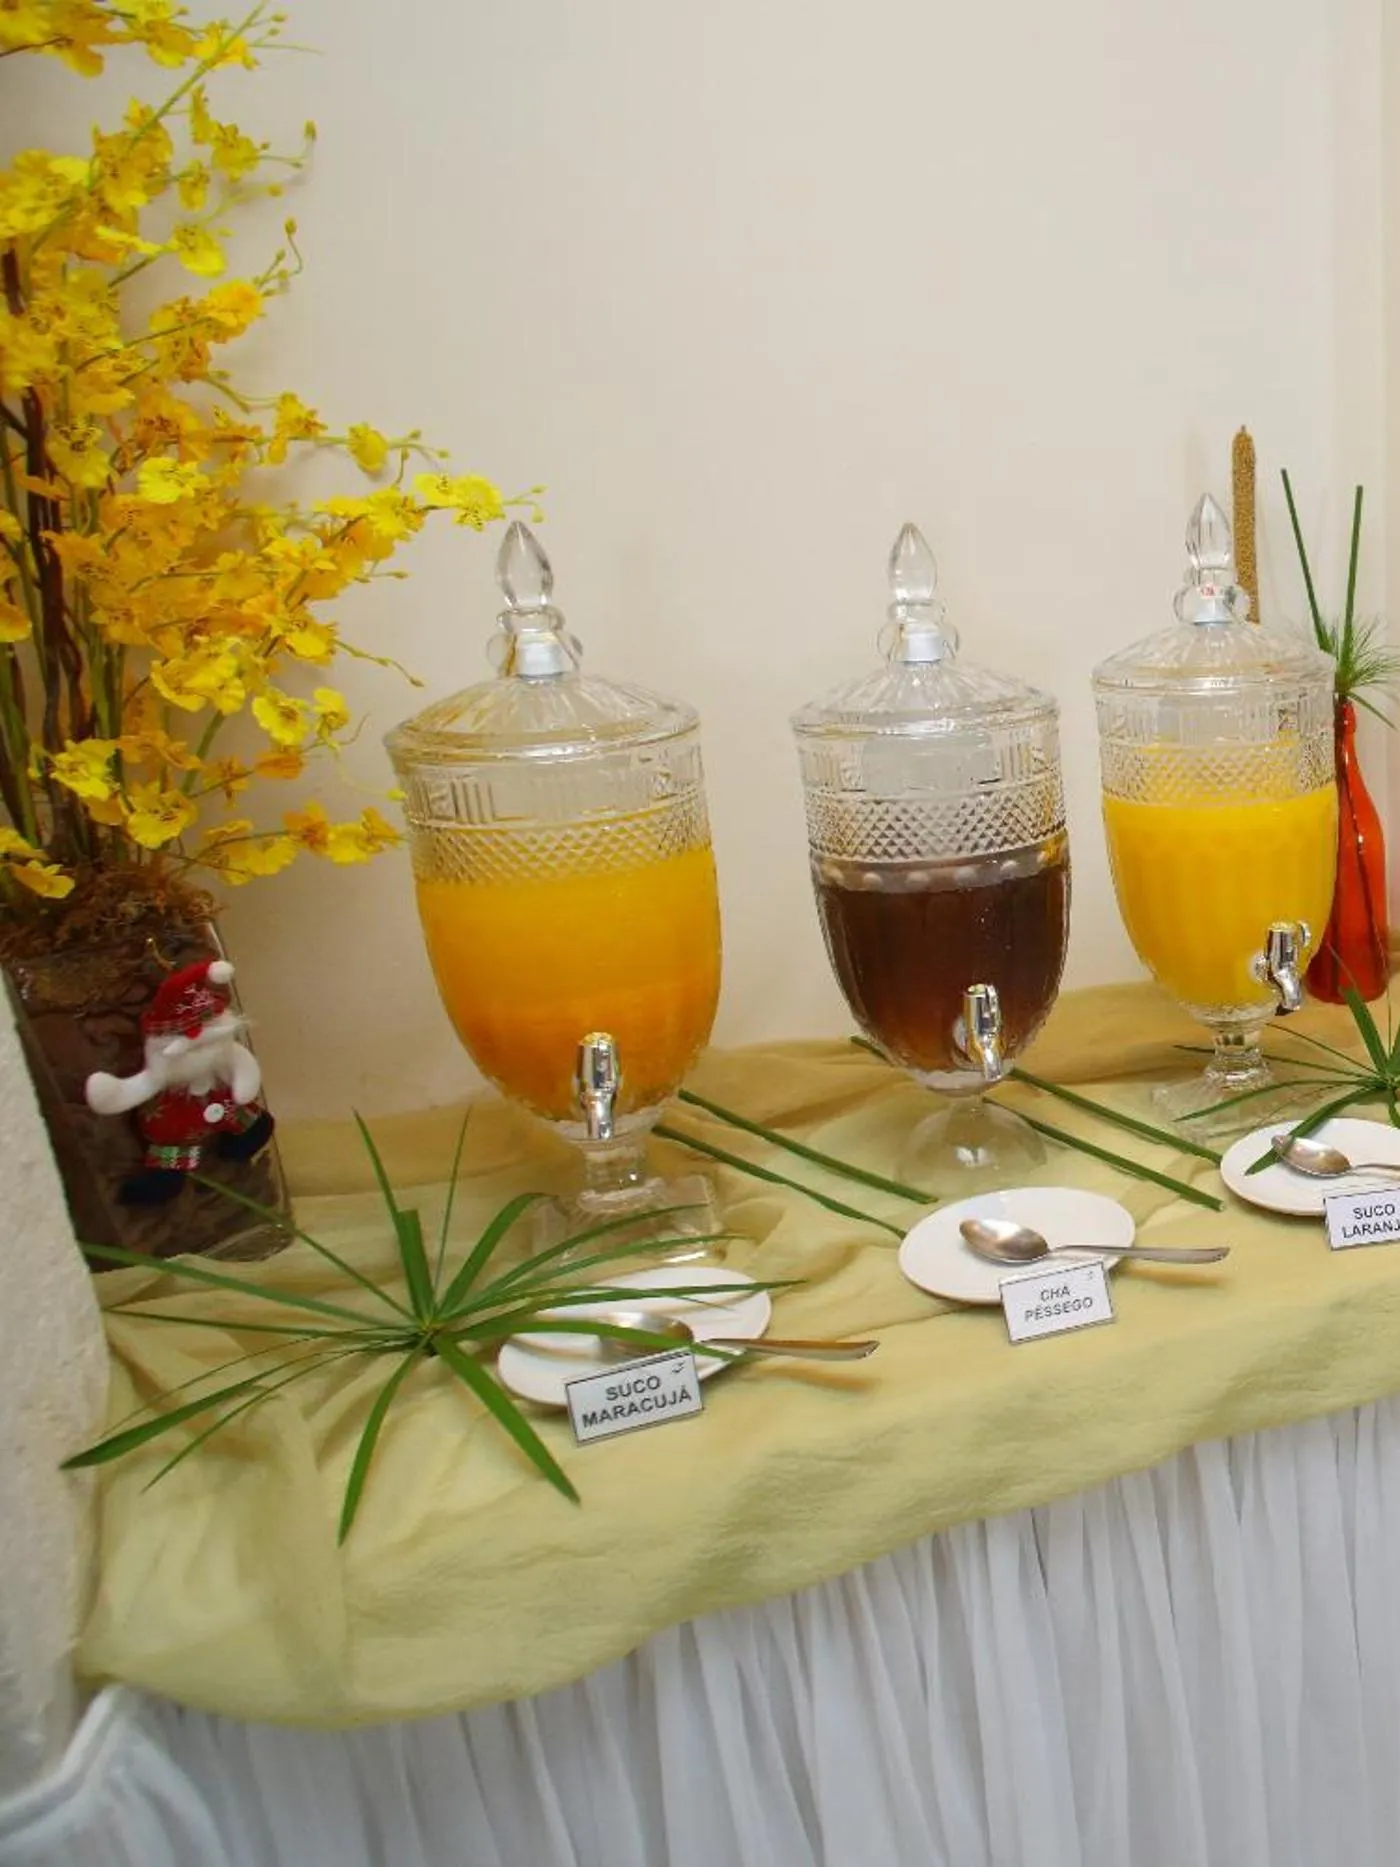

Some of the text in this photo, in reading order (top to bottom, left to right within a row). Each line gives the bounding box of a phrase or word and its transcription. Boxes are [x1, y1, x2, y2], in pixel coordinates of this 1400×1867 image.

[1353, 1203, 1396, 1220] SUCO
[605, 1375, 661, 1401] SUCO
[582, 1385, 692, 1429] MARACUJÁ
